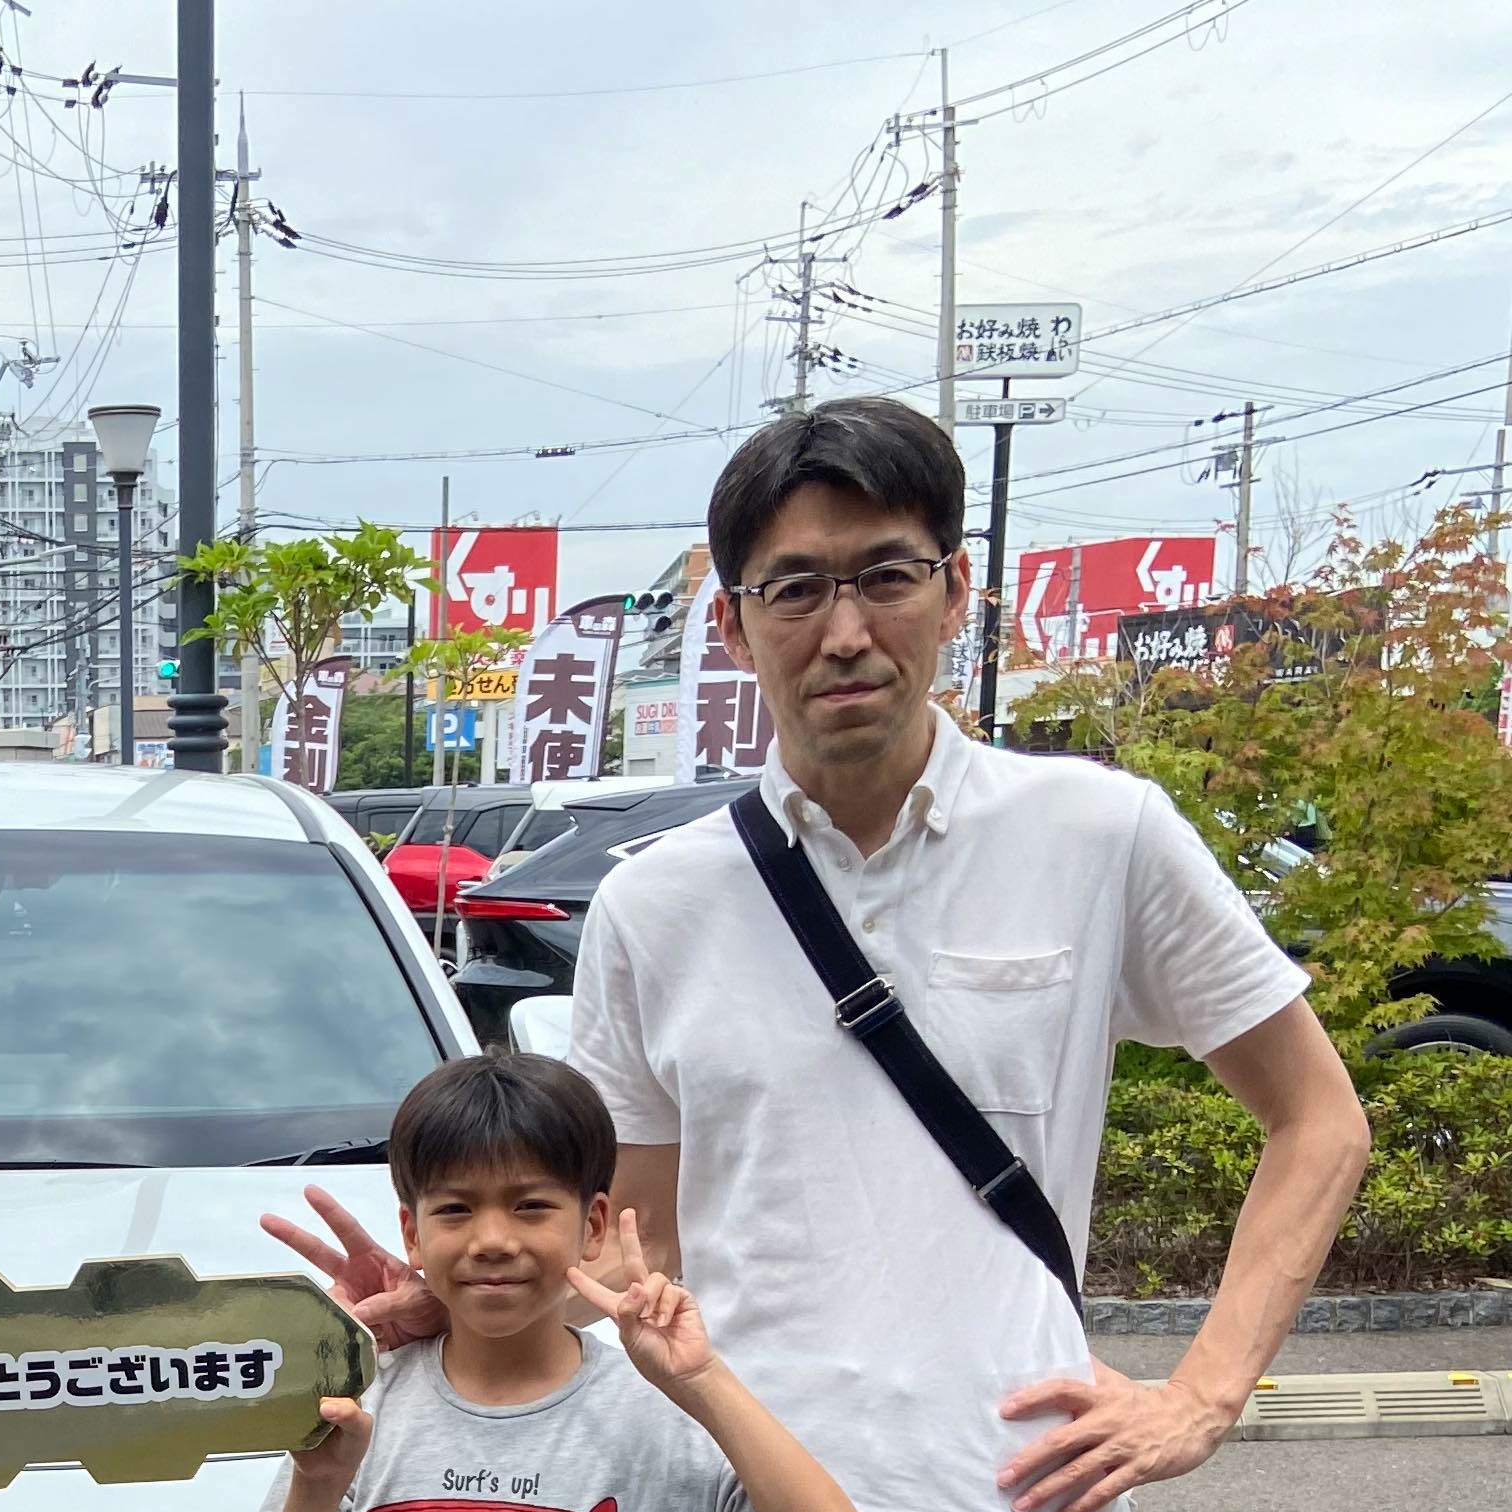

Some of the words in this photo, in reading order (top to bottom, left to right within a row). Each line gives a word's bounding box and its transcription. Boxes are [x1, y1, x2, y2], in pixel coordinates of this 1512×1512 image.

[957, 318, 1041, 340] お好み焼
[446, 531, 550, 639] くすり
[1135, 541, 1210, 612] くすり
[525, 653, 596, 781] 未使
[636, 704, 658, 719] SUGI
[441, 1468, 499, 1493] Surf's
[511, 1472, 541, 1499] up!
